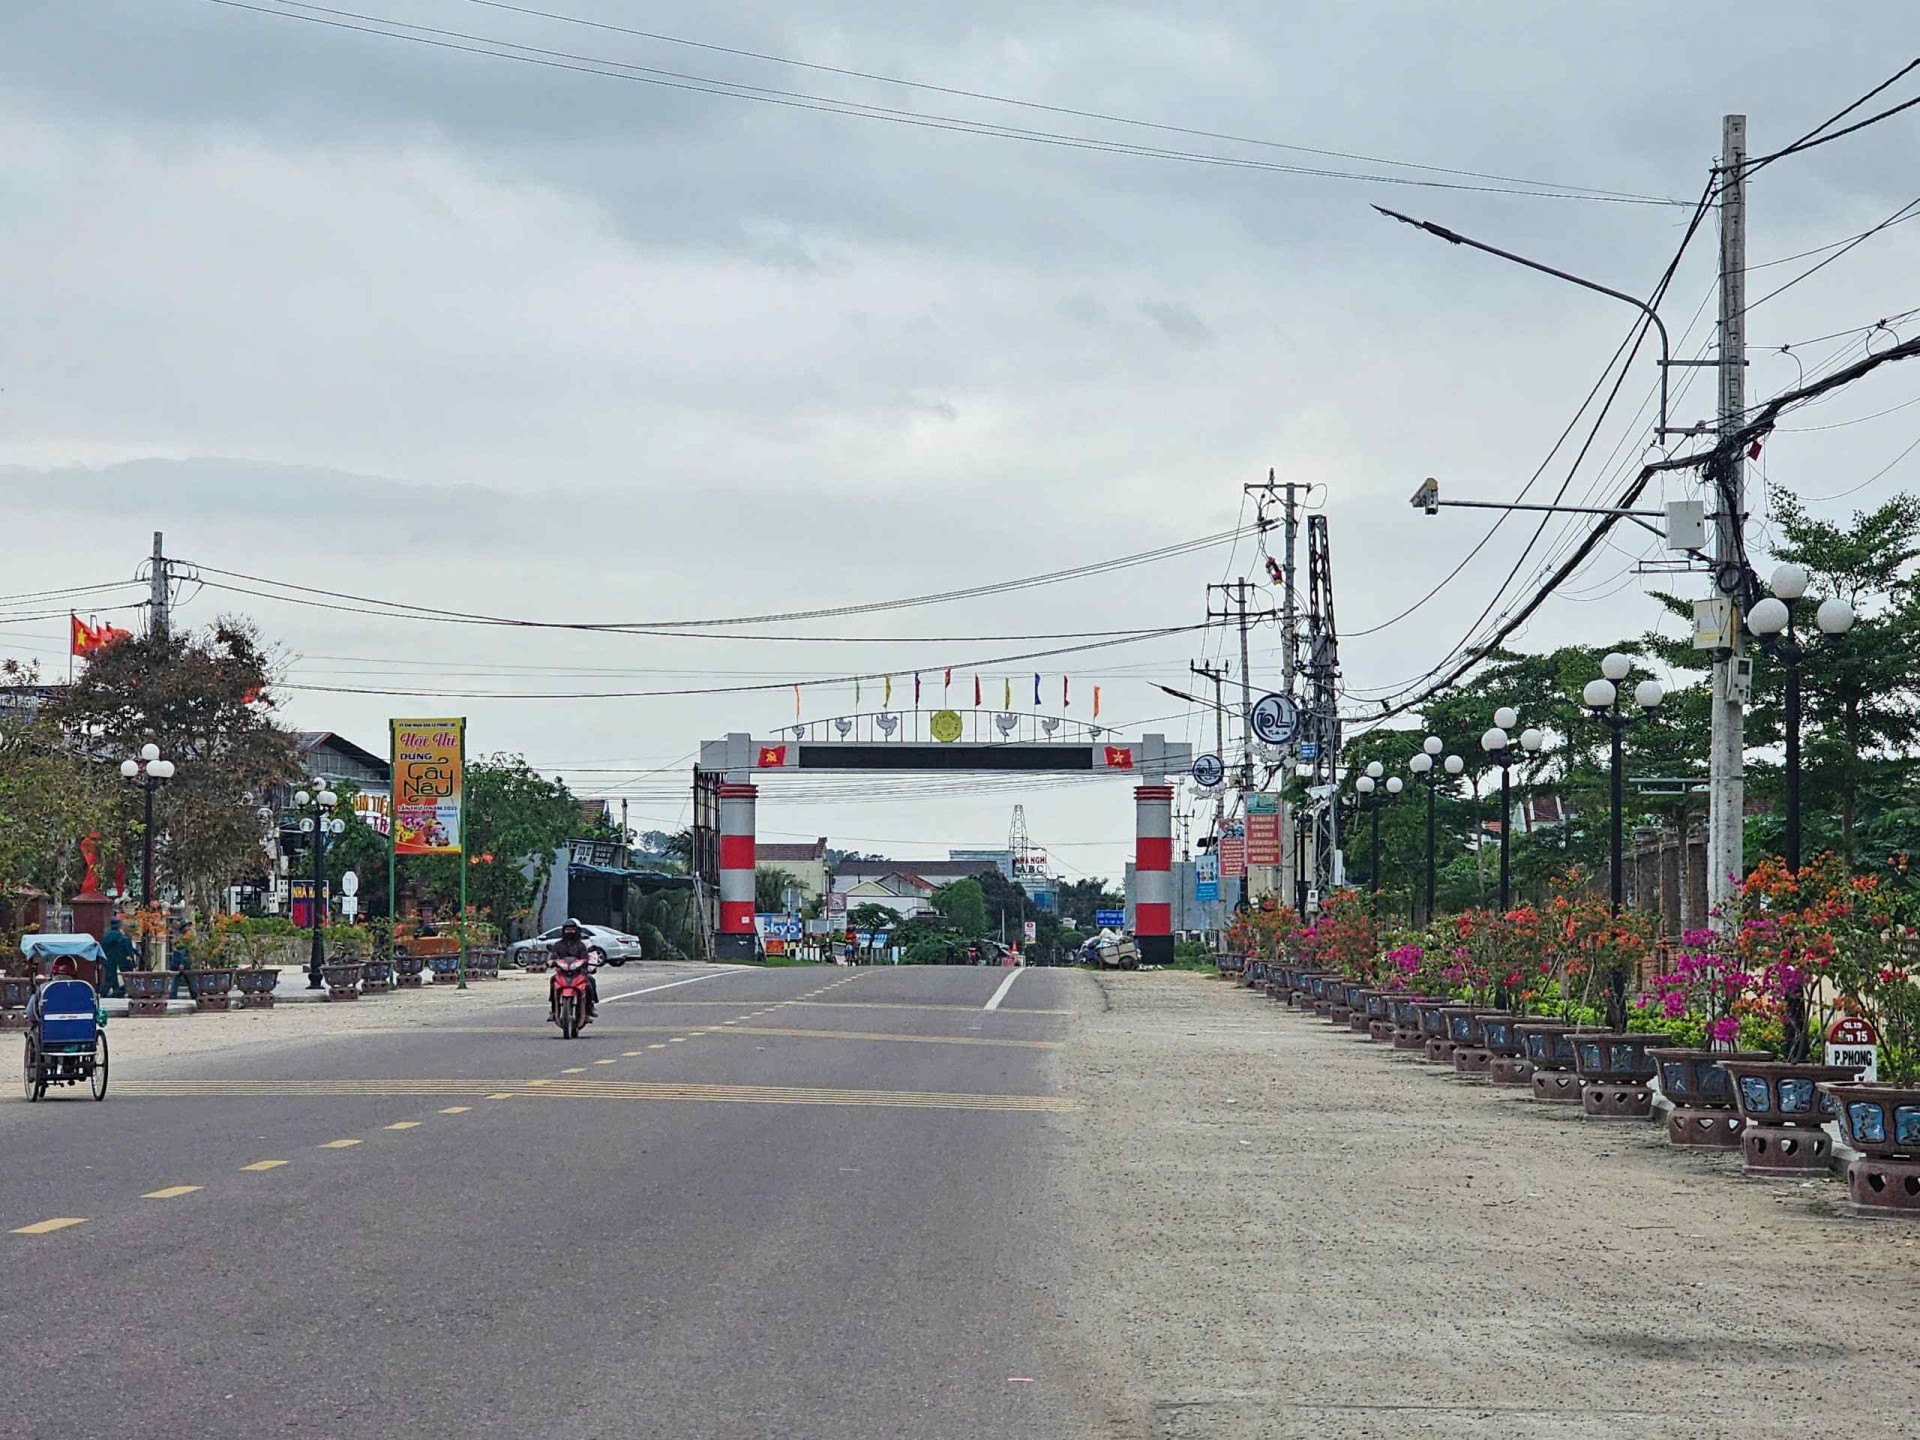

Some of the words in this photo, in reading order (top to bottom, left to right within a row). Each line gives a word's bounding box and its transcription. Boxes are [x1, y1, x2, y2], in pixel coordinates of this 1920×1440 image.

[1843, 1021, 1863, 1029] QL19
[1856, 1030, 1868, 1042] 15
[1834, 1050, 1872, 1067] P.PHONG
